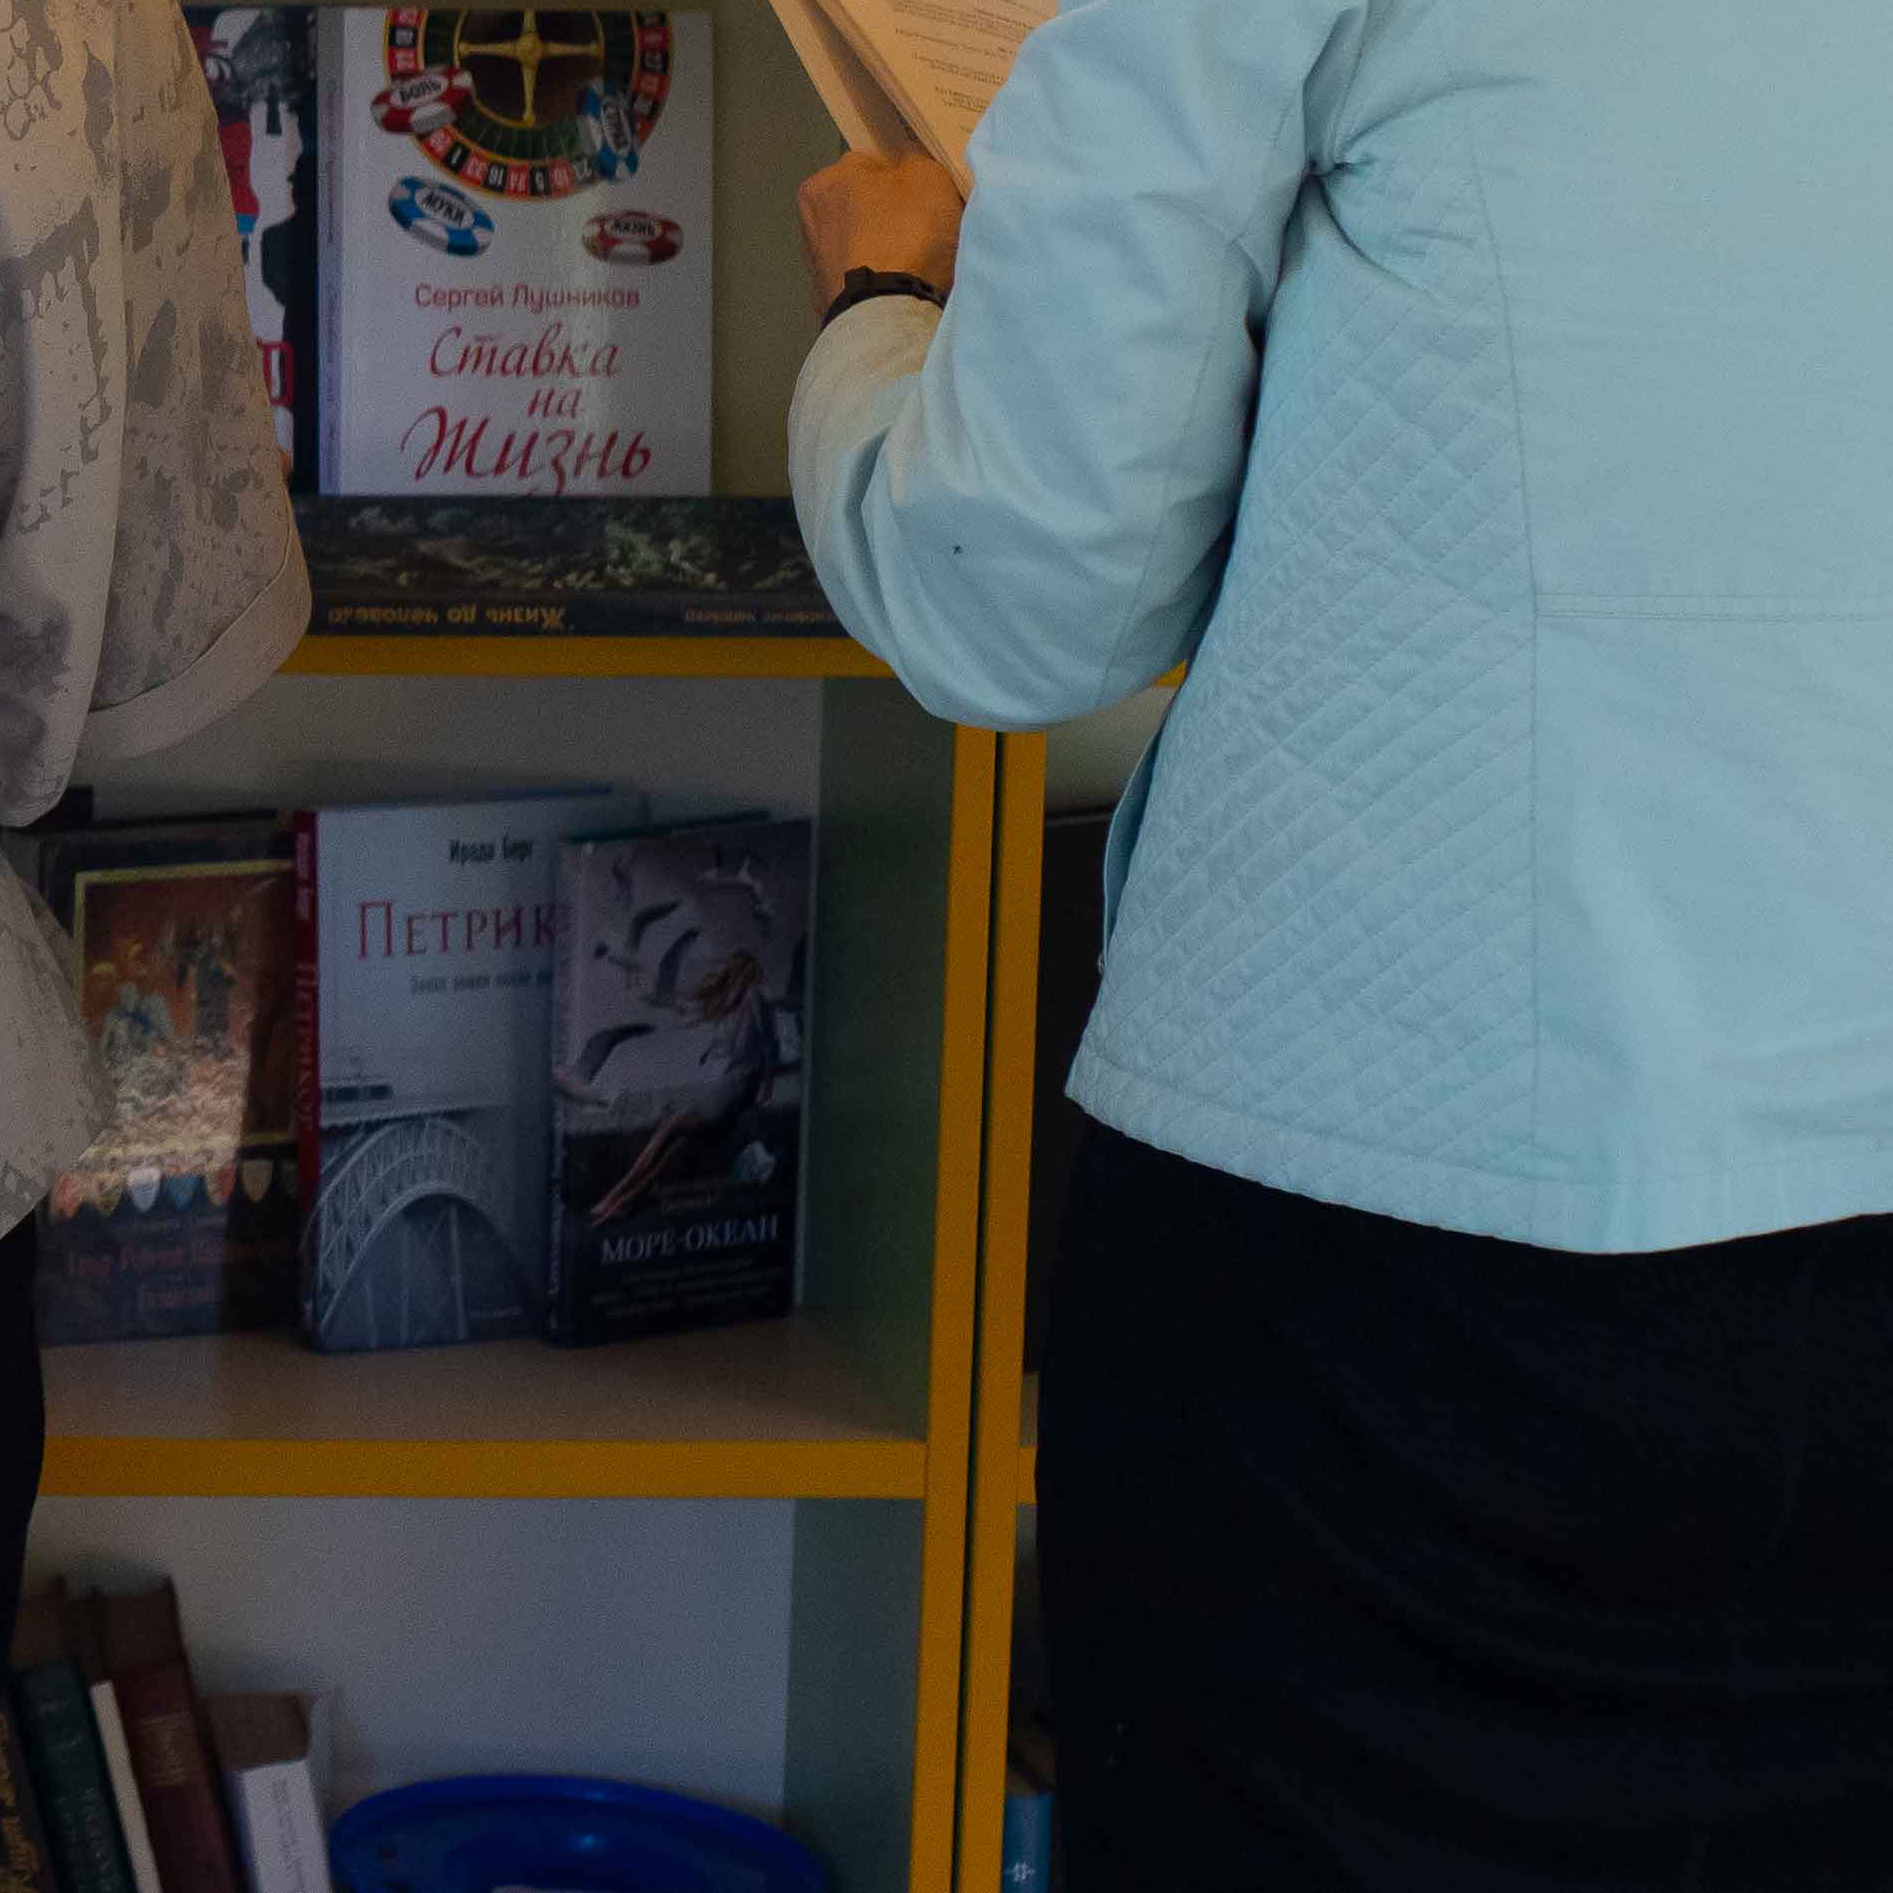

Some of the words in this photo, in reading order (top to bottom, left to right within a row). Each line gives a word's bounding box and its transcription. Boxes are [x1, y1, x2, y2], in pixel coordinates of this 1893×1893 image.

[421, 187, 465, 226] МУКИ
[414, 282, 505, 312] Сергей
[428, 320, 622, 378] Ставка
[527, 387, 582, 419] на
[400, 404, 653, 499] Жизнь
[446, 604, 477, 624] до
[485, 606, 566, 630] Жизнь
[600, 1214, 779, 1266] МОРЕ-ОКЕАН
